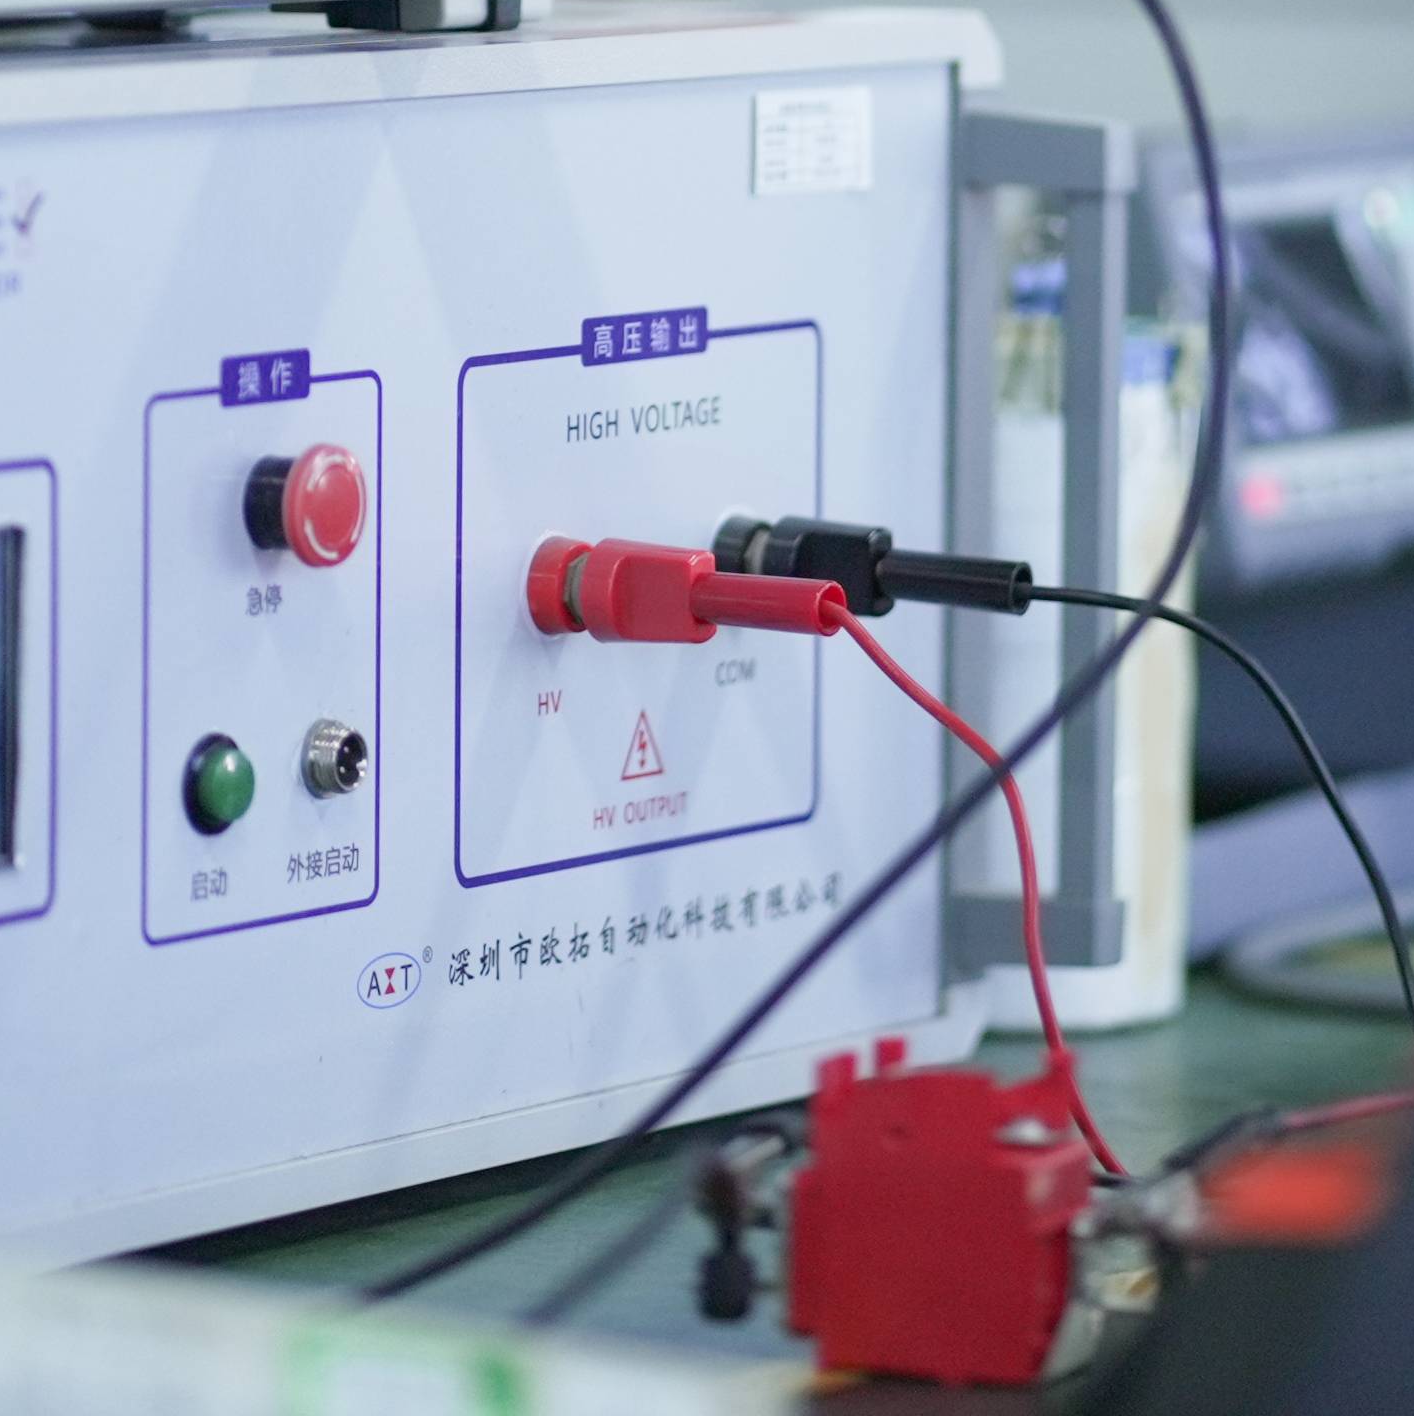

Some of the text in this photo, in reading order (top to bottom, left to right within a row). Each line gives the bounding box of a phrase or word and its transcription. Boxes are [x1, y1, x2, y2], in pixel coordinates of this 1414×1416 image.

[593, 314, 699, 359] 高压输出
[237, 357, 295, 400] 操作
[567, 395, 721, 443] HIGH VOLTAGE
[245, 584, 282, 616] 急停
[715, 657, 757, 687] COM
[537, 689, 563, 717] HV
[593, 790, 688, 831] HV OUTPUT
[287, 842, 360, 884] 外接启动
[190, 867, 228, 903] 启动
[448, 871, 843, 987] 深圳市欧拓自动化科技有限公司
